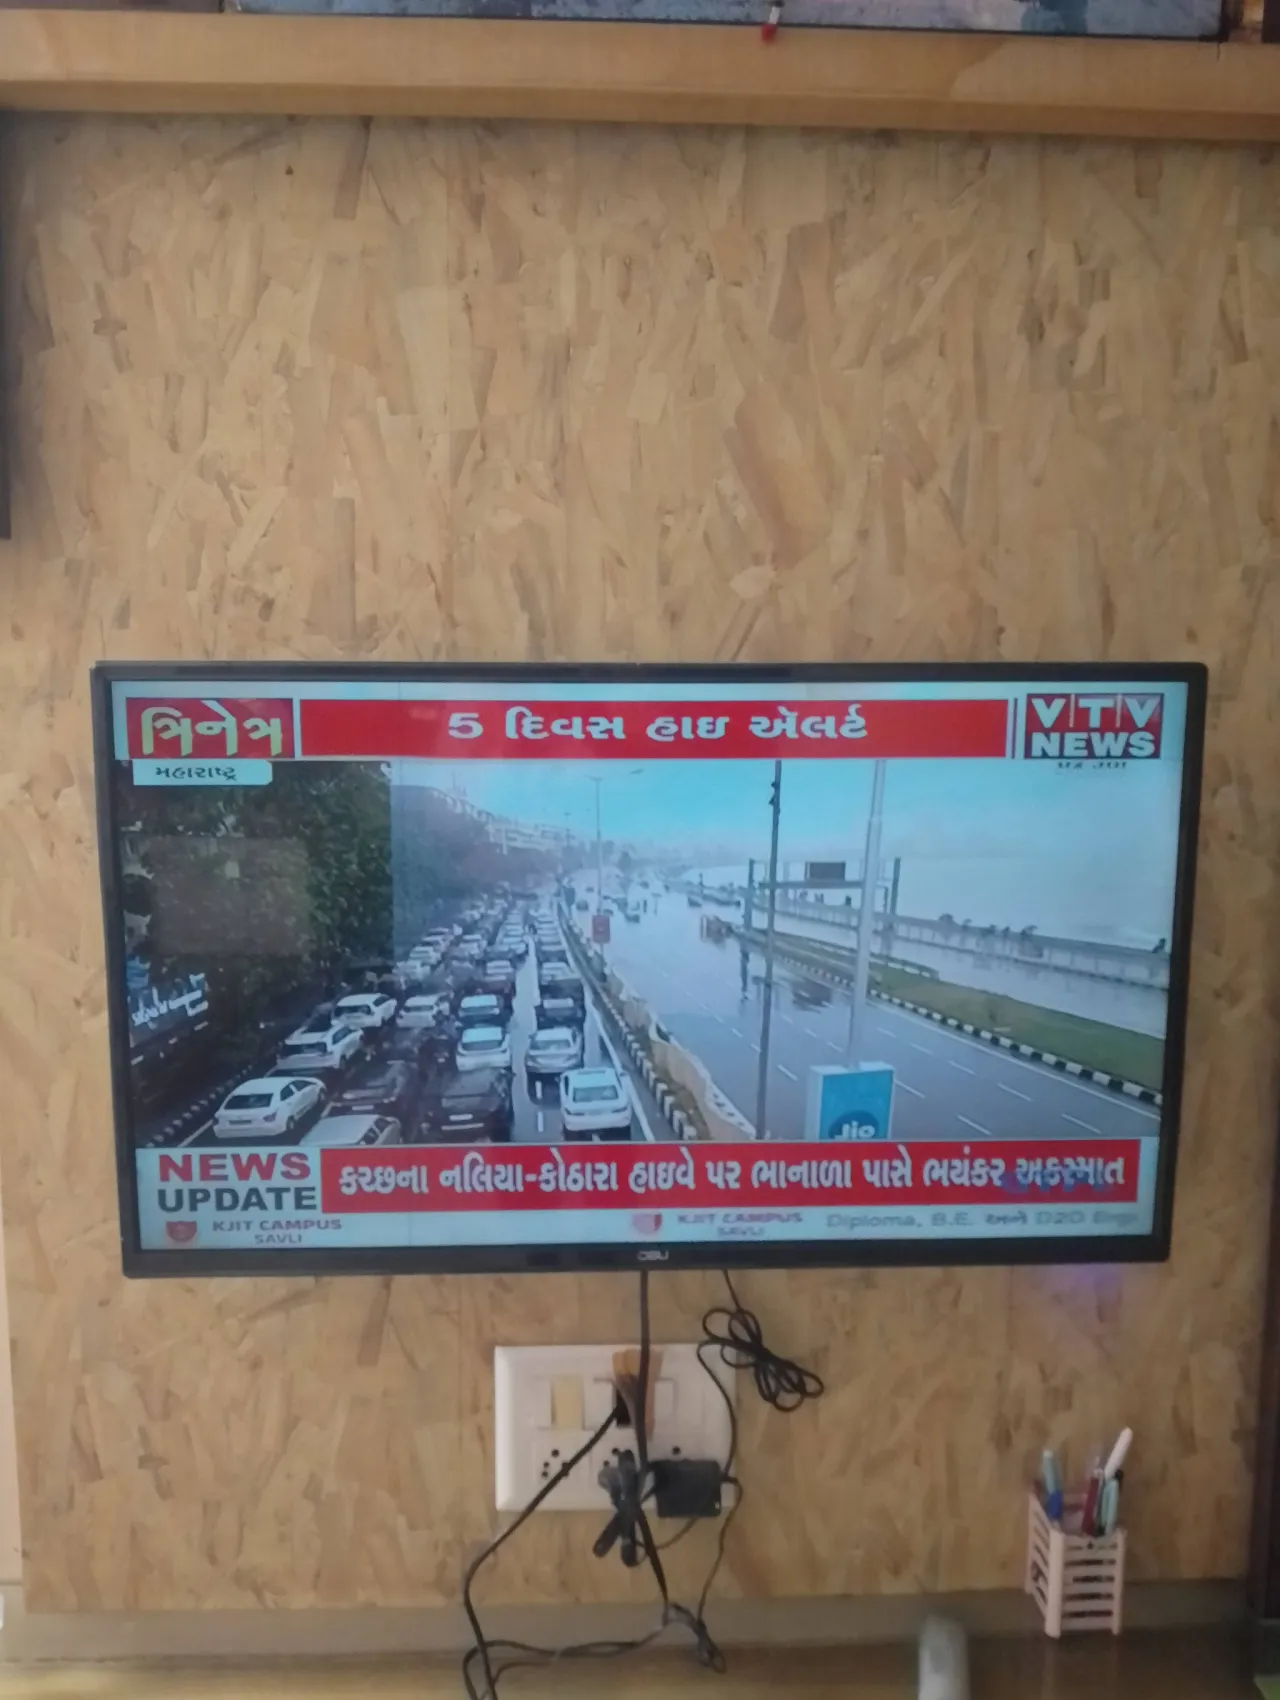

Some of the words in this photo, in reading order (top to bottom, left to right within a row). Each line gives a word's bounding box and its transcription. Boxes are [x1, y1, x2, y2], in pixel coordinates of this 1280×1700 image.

[448, 712, 484, 740] 5
[505, 705, 627, 740] દિવસ
[1031, 697, 1160, 729] VTV
[1031, 731, 1156, 758] NEWS
[158, 1152, 311, 1182] NEWS
[705, 1161, 742, 1190] પર
[750, 1160, 853, 1189] ભાનાળા
[862, 1144, 913, 1188] પાસે
[922, 1144, 1006, 1187] ભયંકર
[157, 1186, 318, 1213] UPDATE
[212, 1220, 252, 1232] KJIT
[259, 1219, 342, 1231] CAMPUS
[254, 1234, 303, 1244] SAVLI
